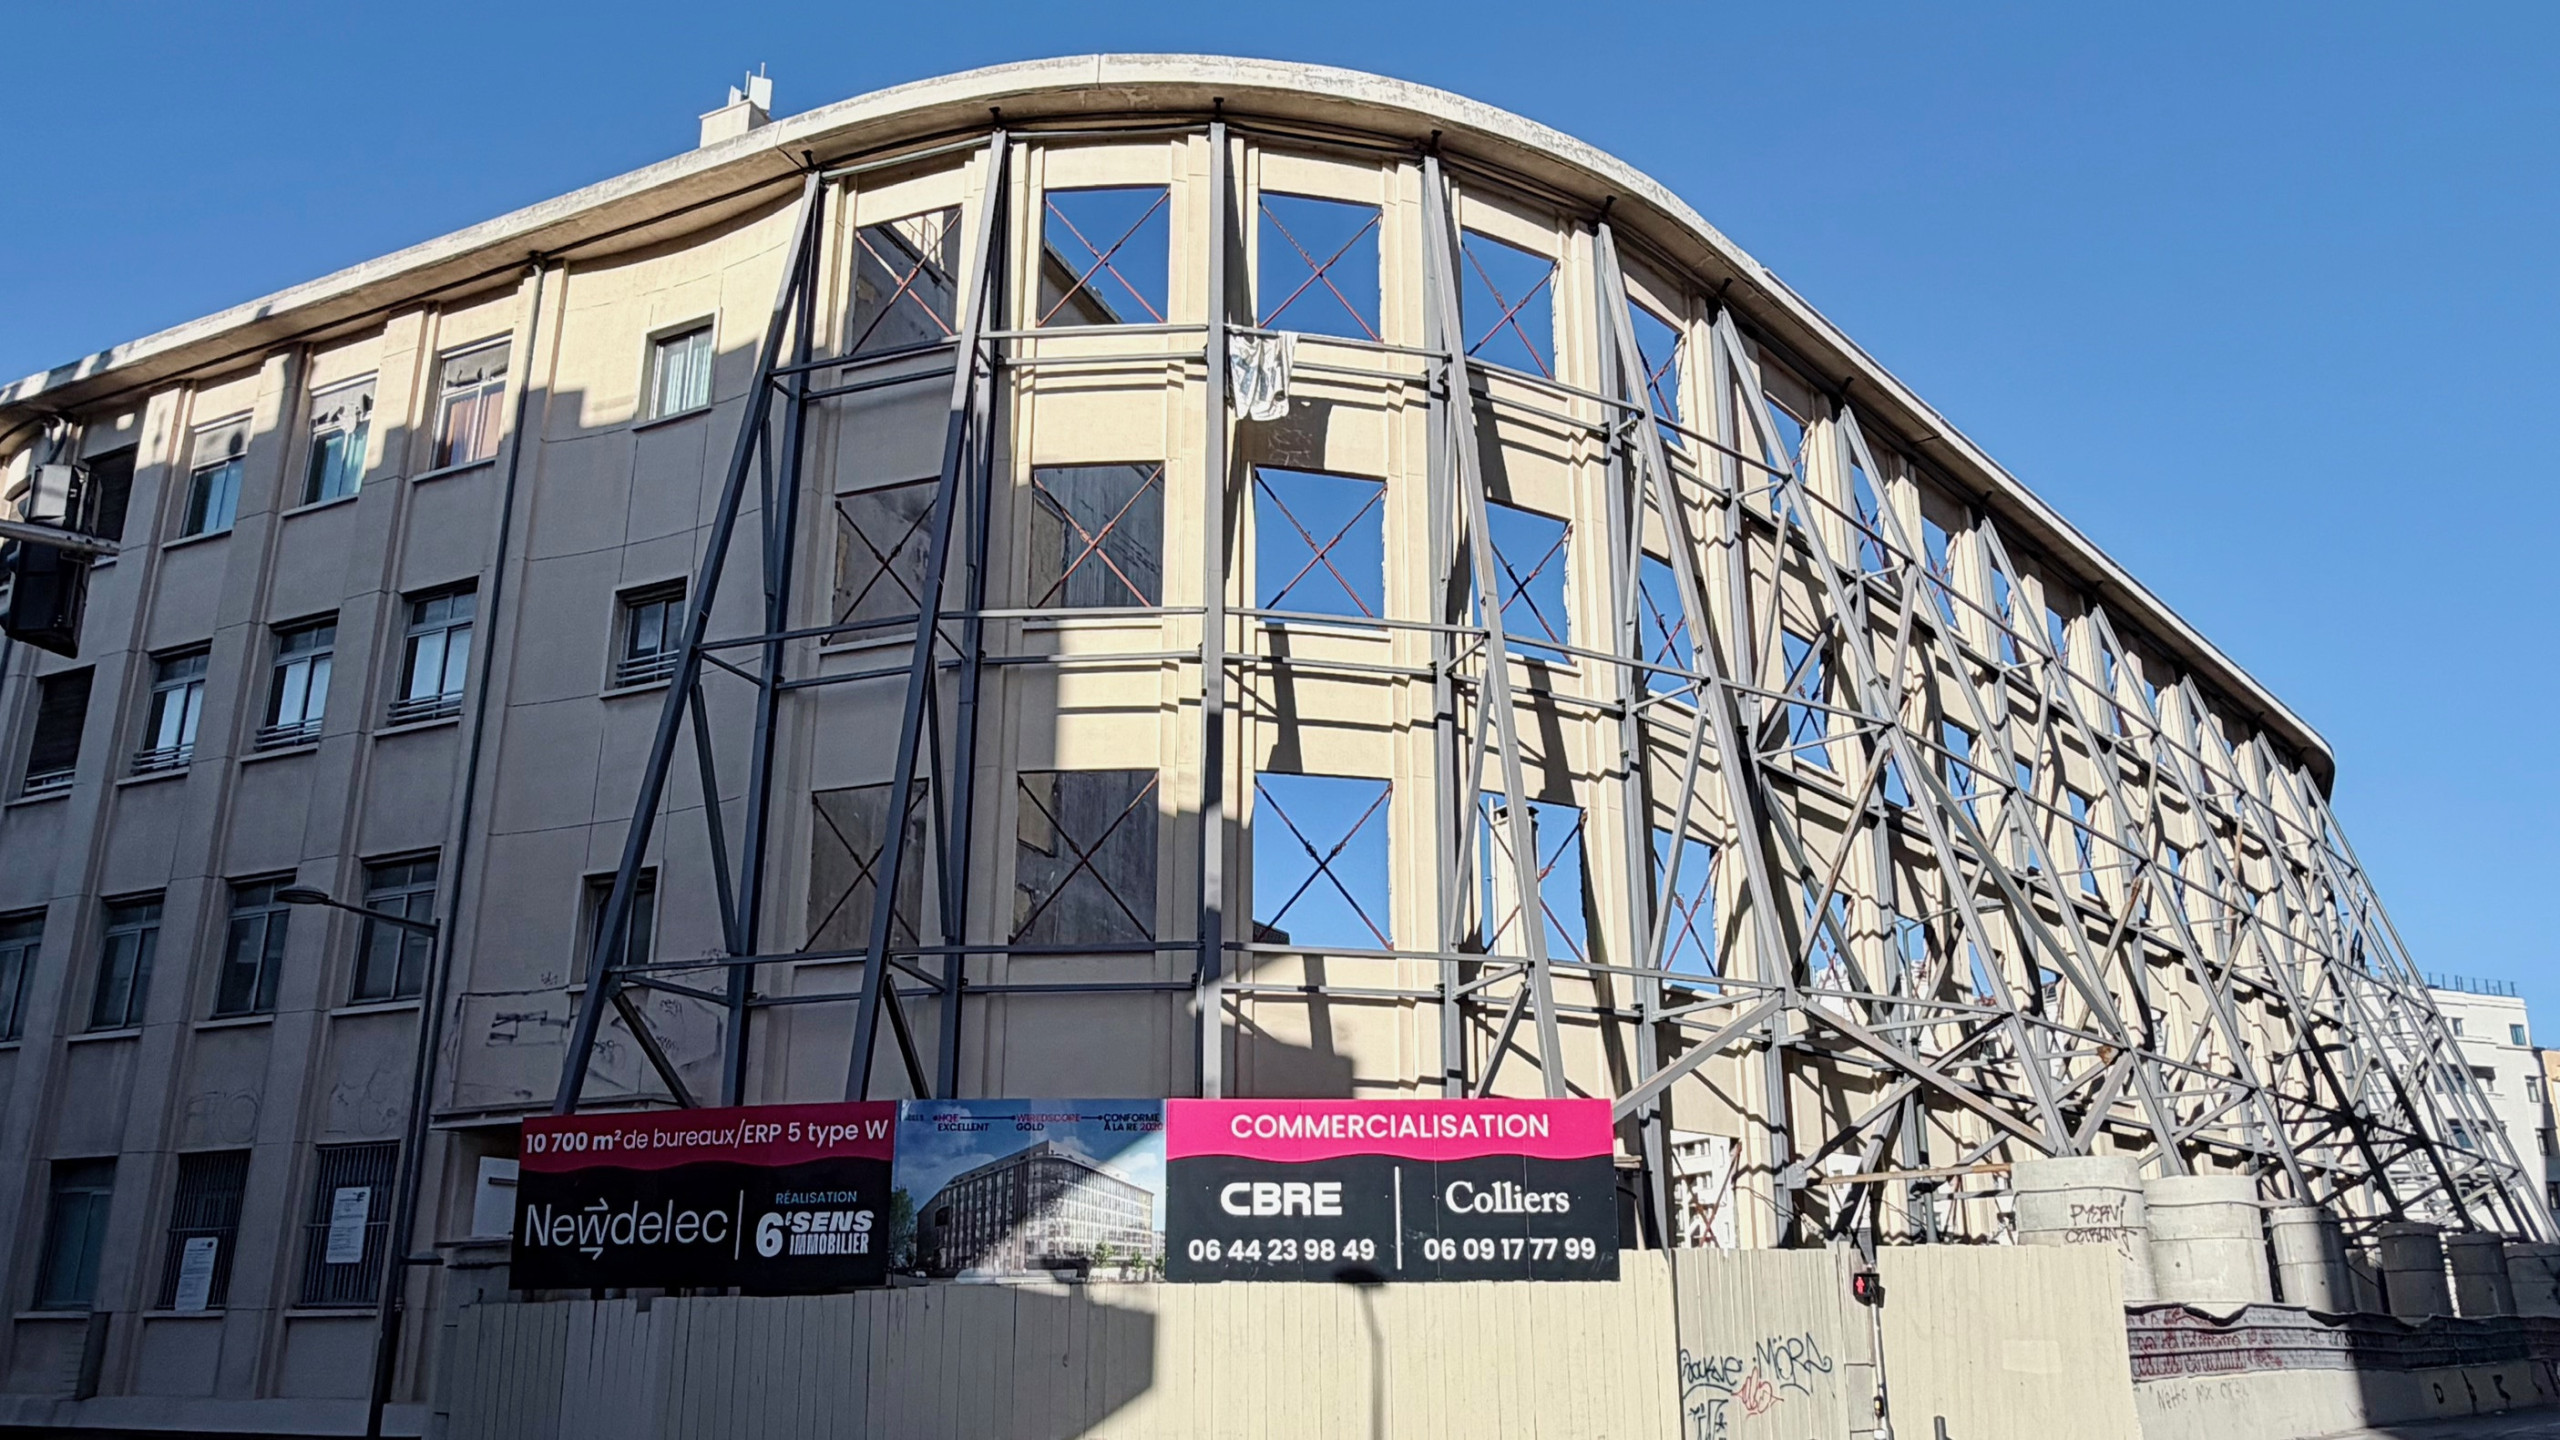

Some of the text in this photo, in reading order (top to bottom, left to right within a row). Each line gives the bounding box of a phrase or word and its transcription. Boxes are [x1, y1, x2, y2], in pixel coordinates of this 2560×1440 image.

[937, 1122, 990, 1132] EXCELLENT
[938, 1113, 959, 1123] HQE
[1015, 1122, 1045, 1132] GOLD
[1103, 1112, 1160, 1122] CONFORME
[1112, 1122, 1125, 1131] LA
[1126, 1122, 1138, 1131] RE
[1140, 1122, 1163, 1132] 2020
[1230, 1113, 1550, 1139] COMMERCIALISATION
[526, 1133, 547, 1154] 10
[551, 1132, 588, 1153] 700
[623, 1129, 649, 1150] de
[788, 1121, 801, 1142] 5
[808, 1122, 859, 1148] type
[865, 1119, 889, 1140] W
[775, 1190, 858, 1205] RÉALISATION
[1219, 1181, 1343, 1216] CBRE
[1445, 1180, 1570, 1214] Colliers
[524, 1198, 729, 1247] Newdelec
[791, 1210, 875, 1233] SENS
[789, 1232, 869, 1256] IMMOBILIER
[1188, 1238, 1376, 1262] 06 44 23 98 49
[1423, 1237, 1597, 1261] 06 09 17 77 99
